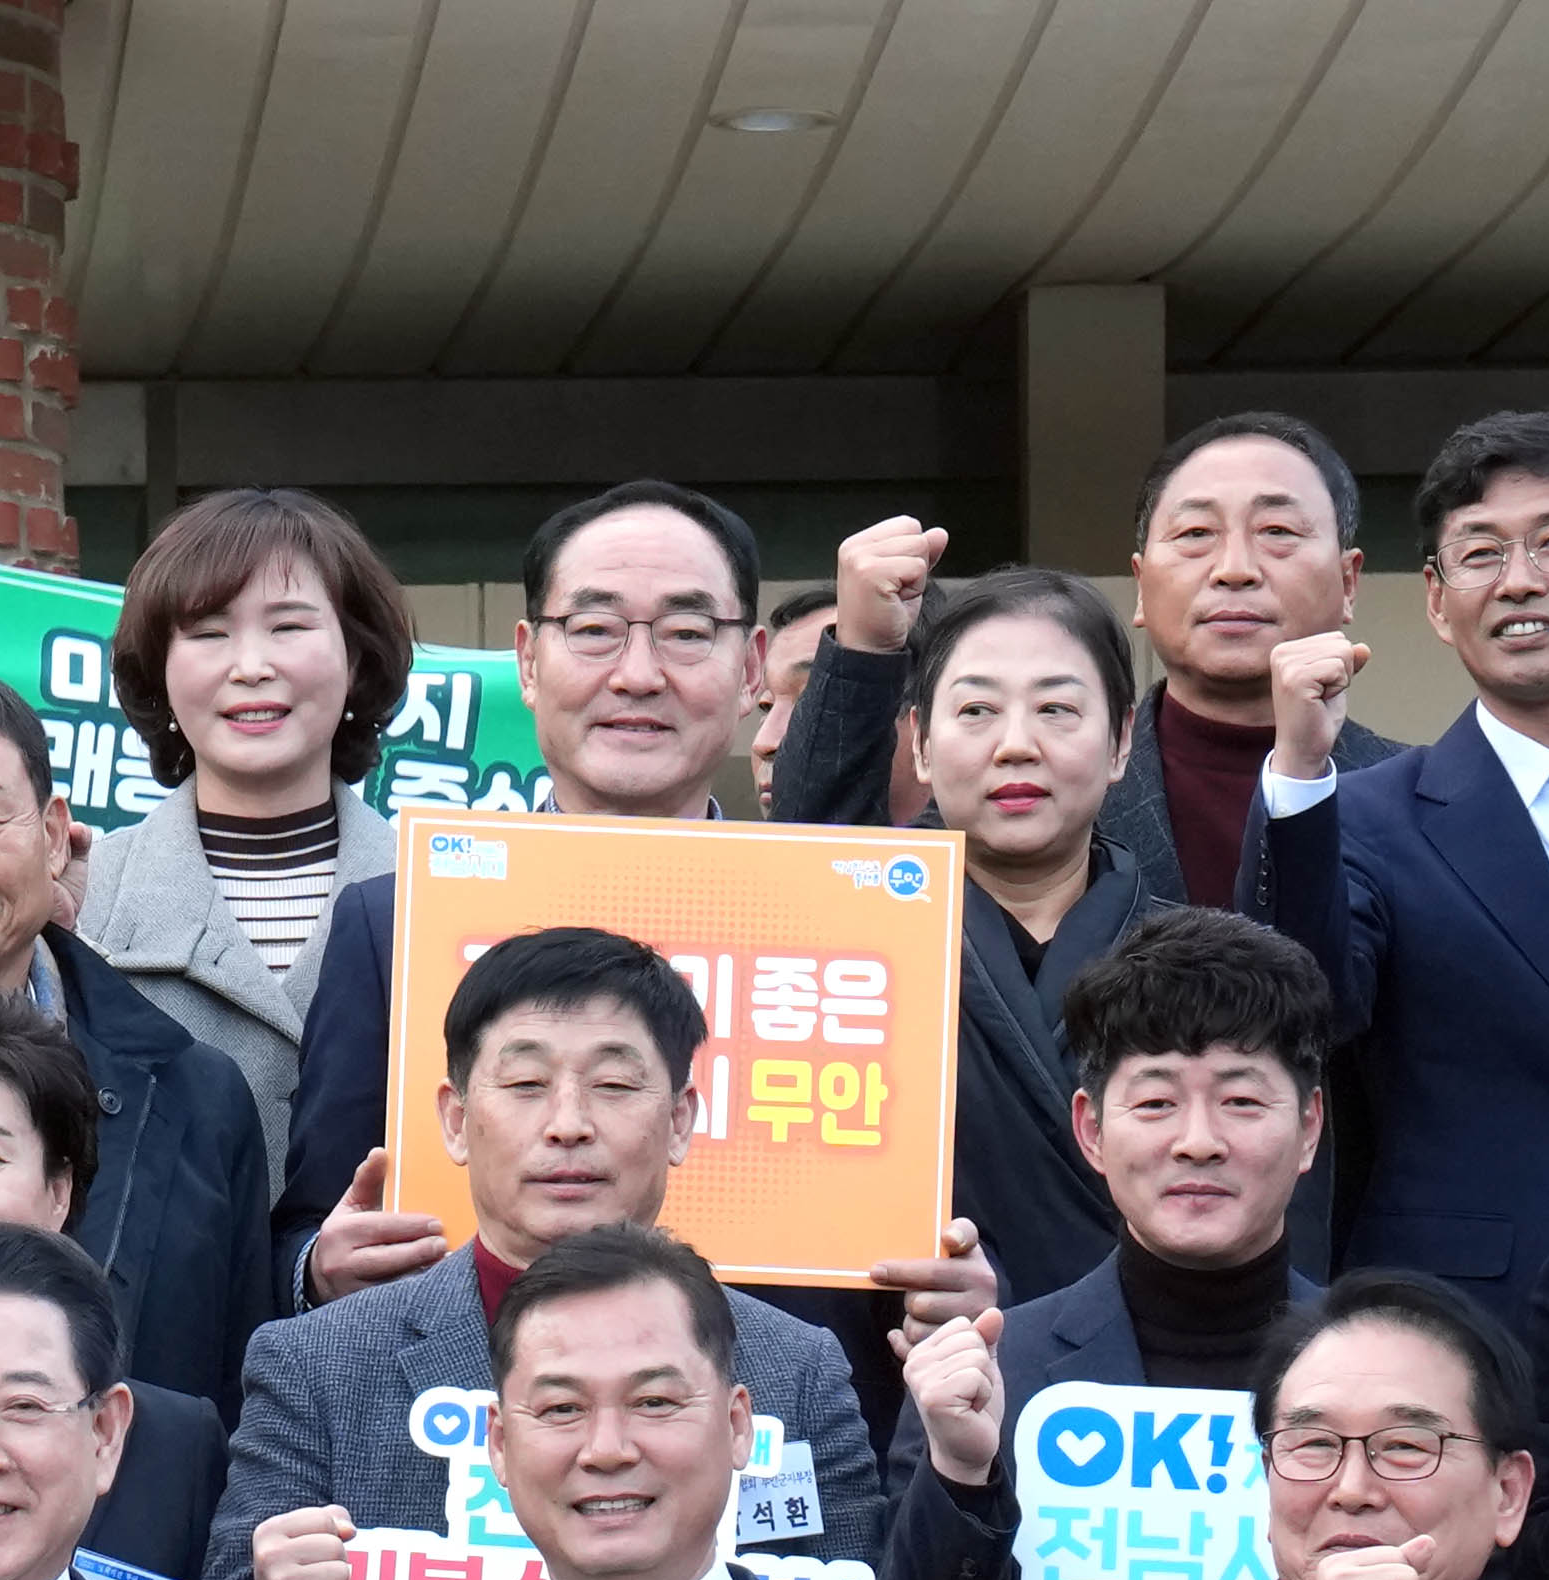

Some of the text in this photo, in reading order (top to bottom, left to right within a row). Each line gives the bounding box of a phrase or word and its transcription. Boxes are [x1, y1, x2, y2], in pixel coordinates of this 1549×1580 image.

[751, 956, 889, 1045] 좋은
[747, 1058, 889, 1147] 무안
[1037, 1406, 1235, 1494] OK!
[737, 1496, 809, 1536] 석환
